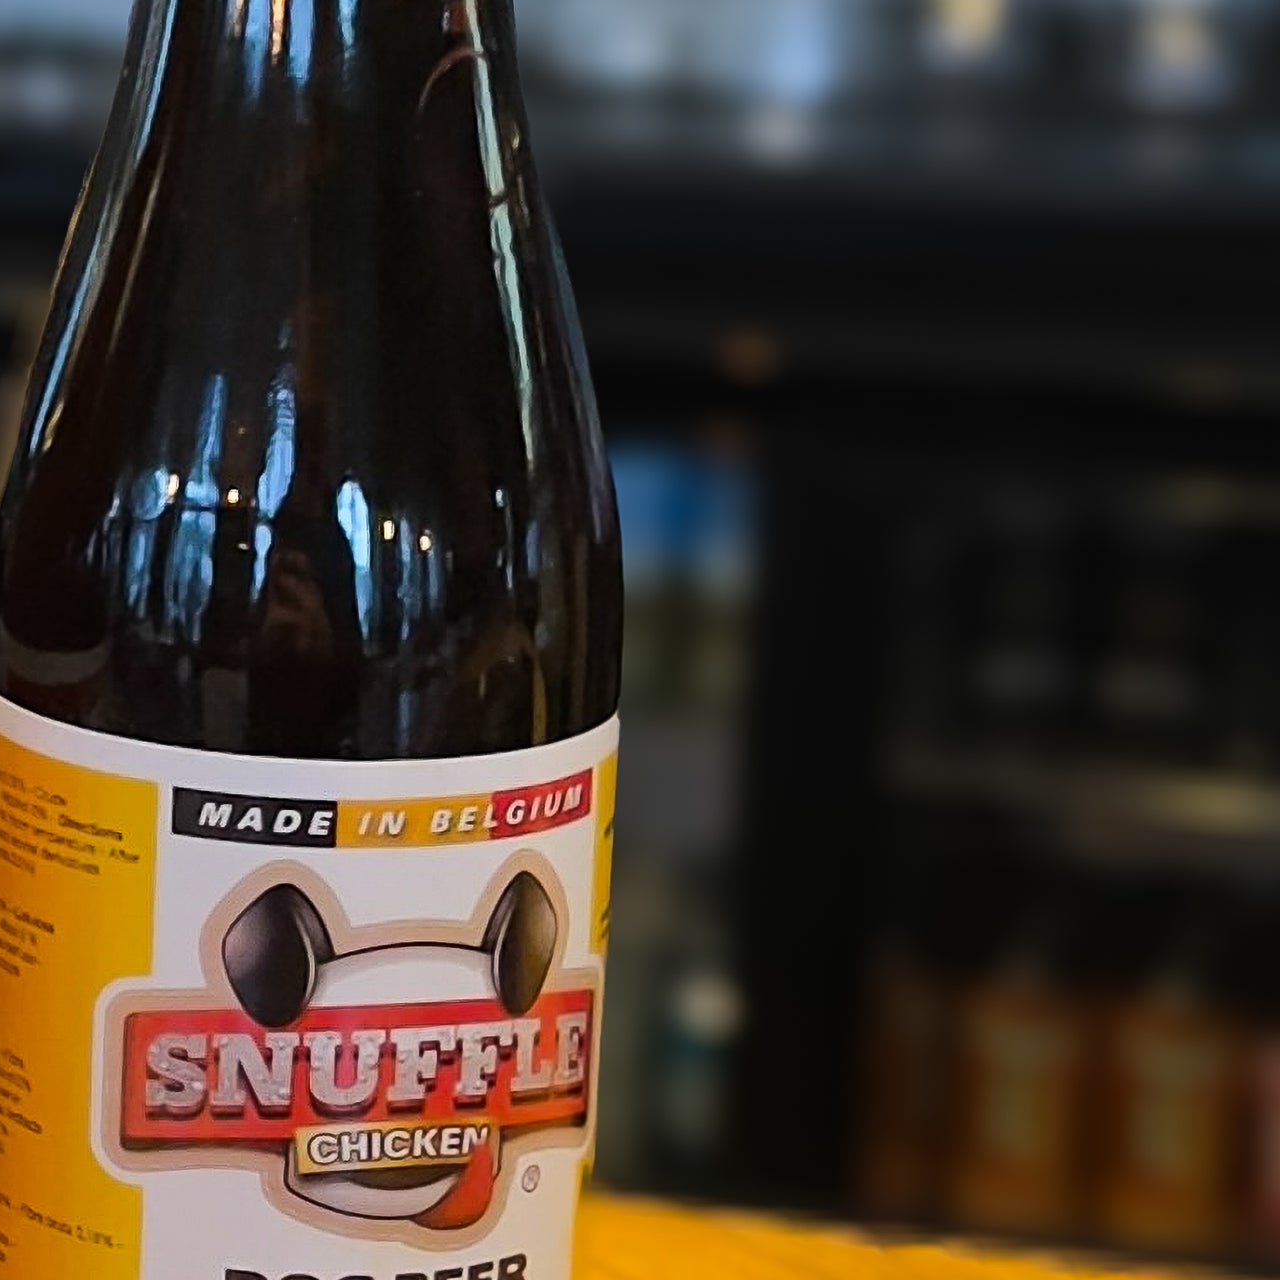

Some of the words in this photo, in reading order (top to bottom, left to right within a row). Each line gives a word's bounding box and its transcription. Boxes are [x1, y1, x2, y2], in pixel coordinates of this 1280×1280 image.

[198, 801, 333, 836] MADE
[358, 812, 406, 835] IN
[431, 783, 582, 835] BELGIUM
[145, 1010, 587, 1120] SNUFFLE
[307, 1126, 488, 1164] CHICKEN
